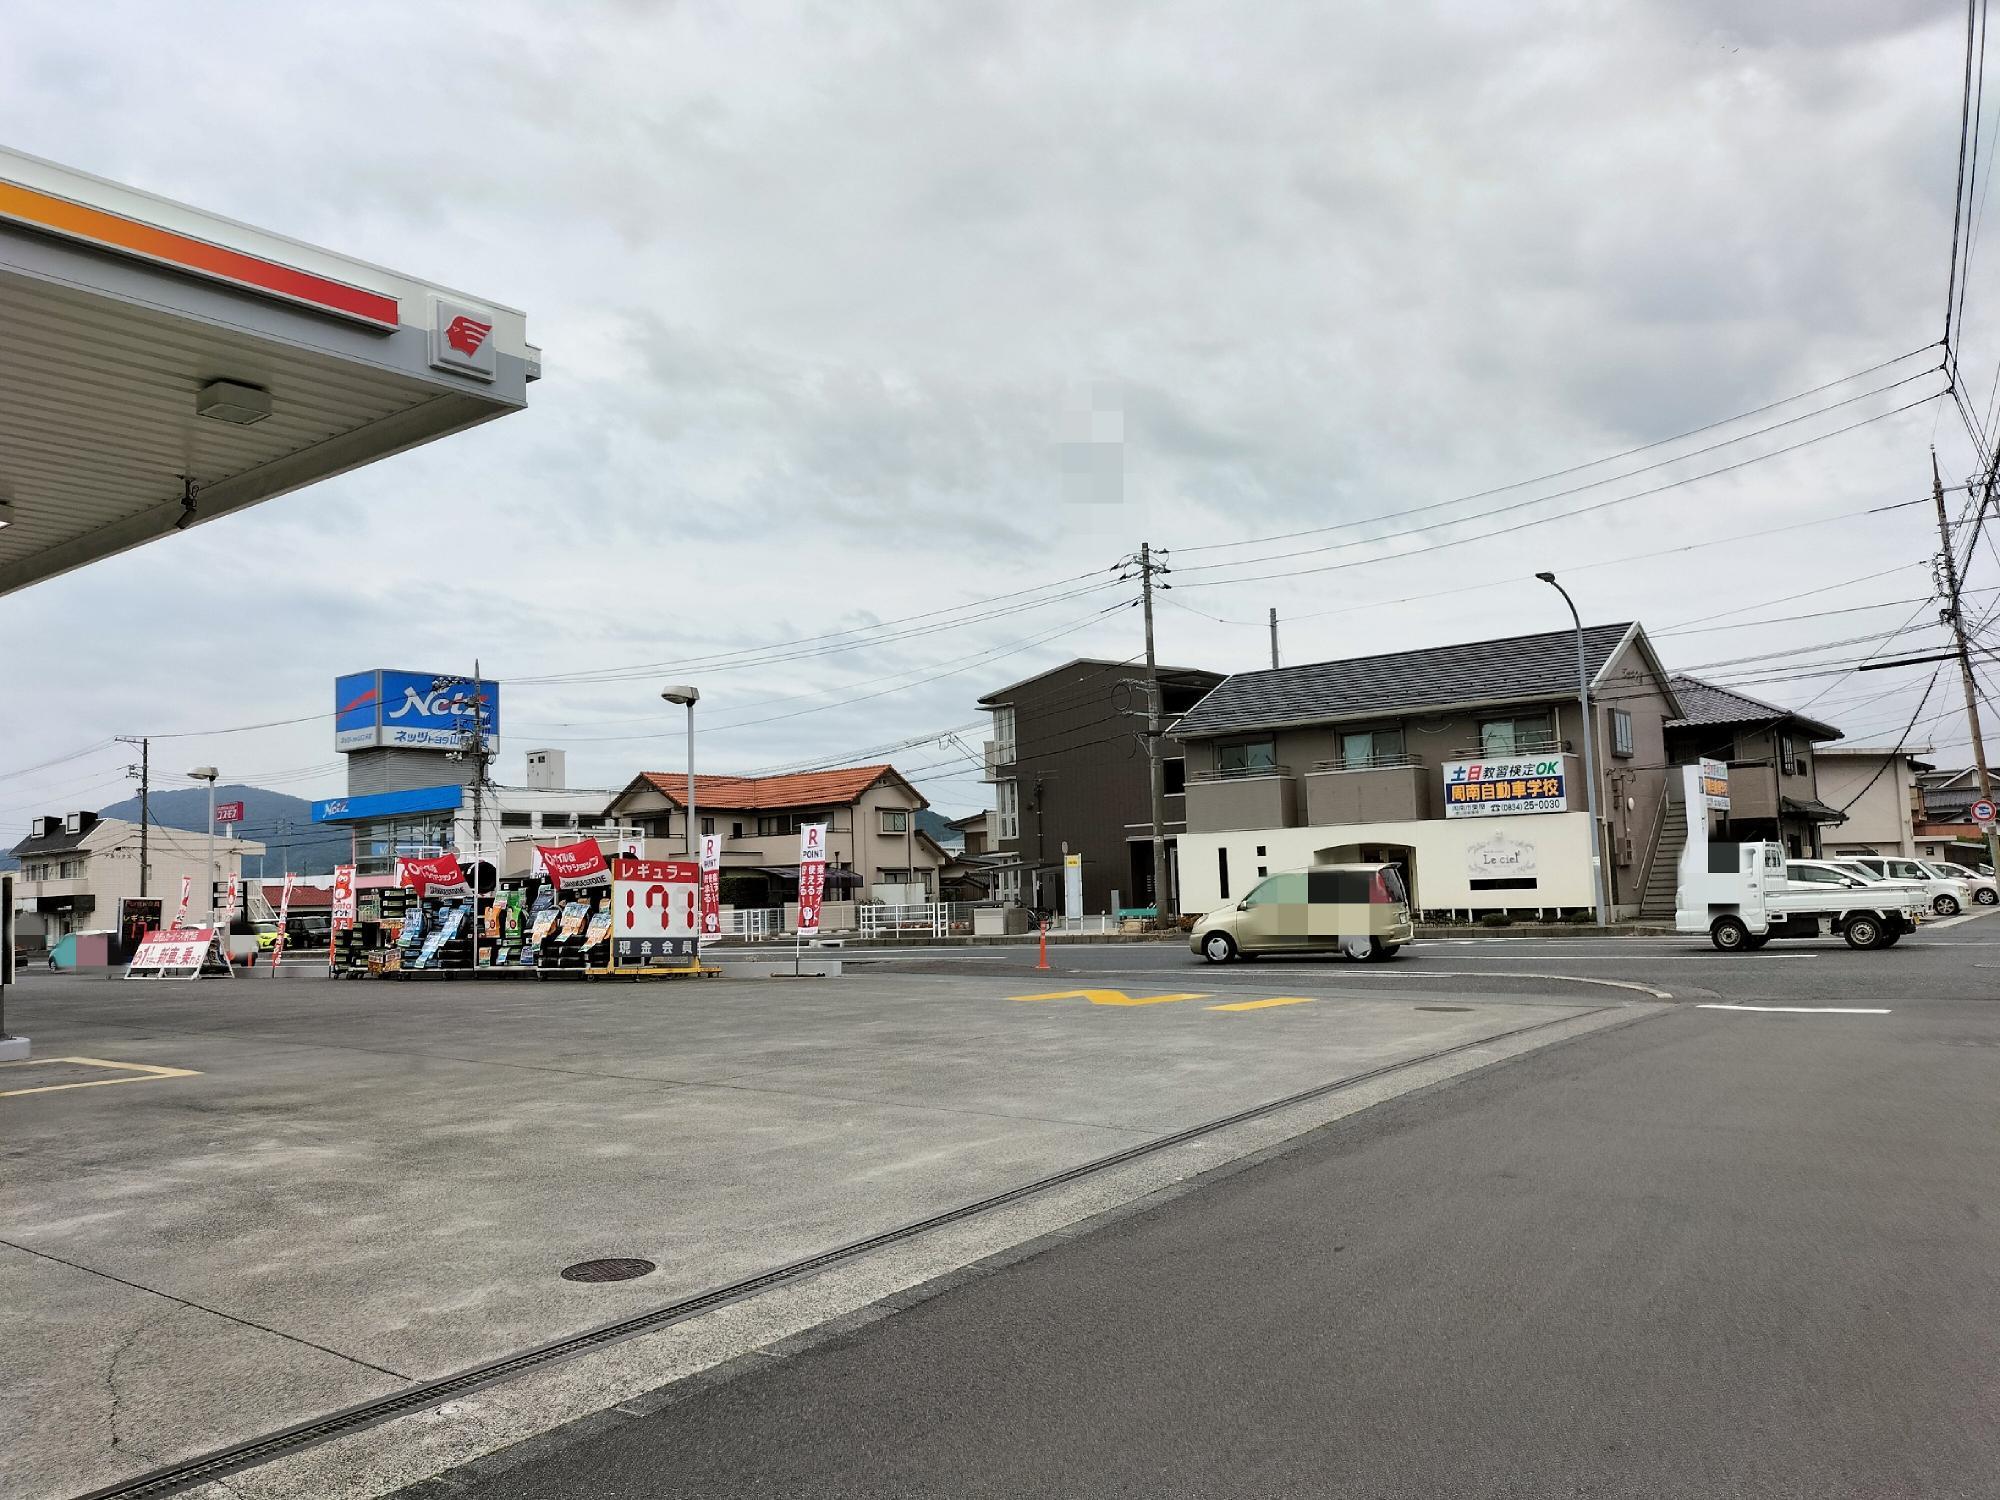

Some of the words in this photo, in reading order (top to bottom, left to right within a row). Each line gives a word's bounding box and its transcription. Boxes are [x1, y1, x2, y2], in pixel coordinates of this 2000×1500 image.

[389, 686, 490, 718] Netz
[1451, 778, 1559, 801] 周南自動車学校
[803, 850, 823, 858] POINT
[1483, 854, 1497, 865] Le
[621, 863, 693, 879] レギュラー
[626, 884, 694, 931] 171
[123, 914, 159, 922] レギュラー
[618, 940, 693, 955] 現金会員
